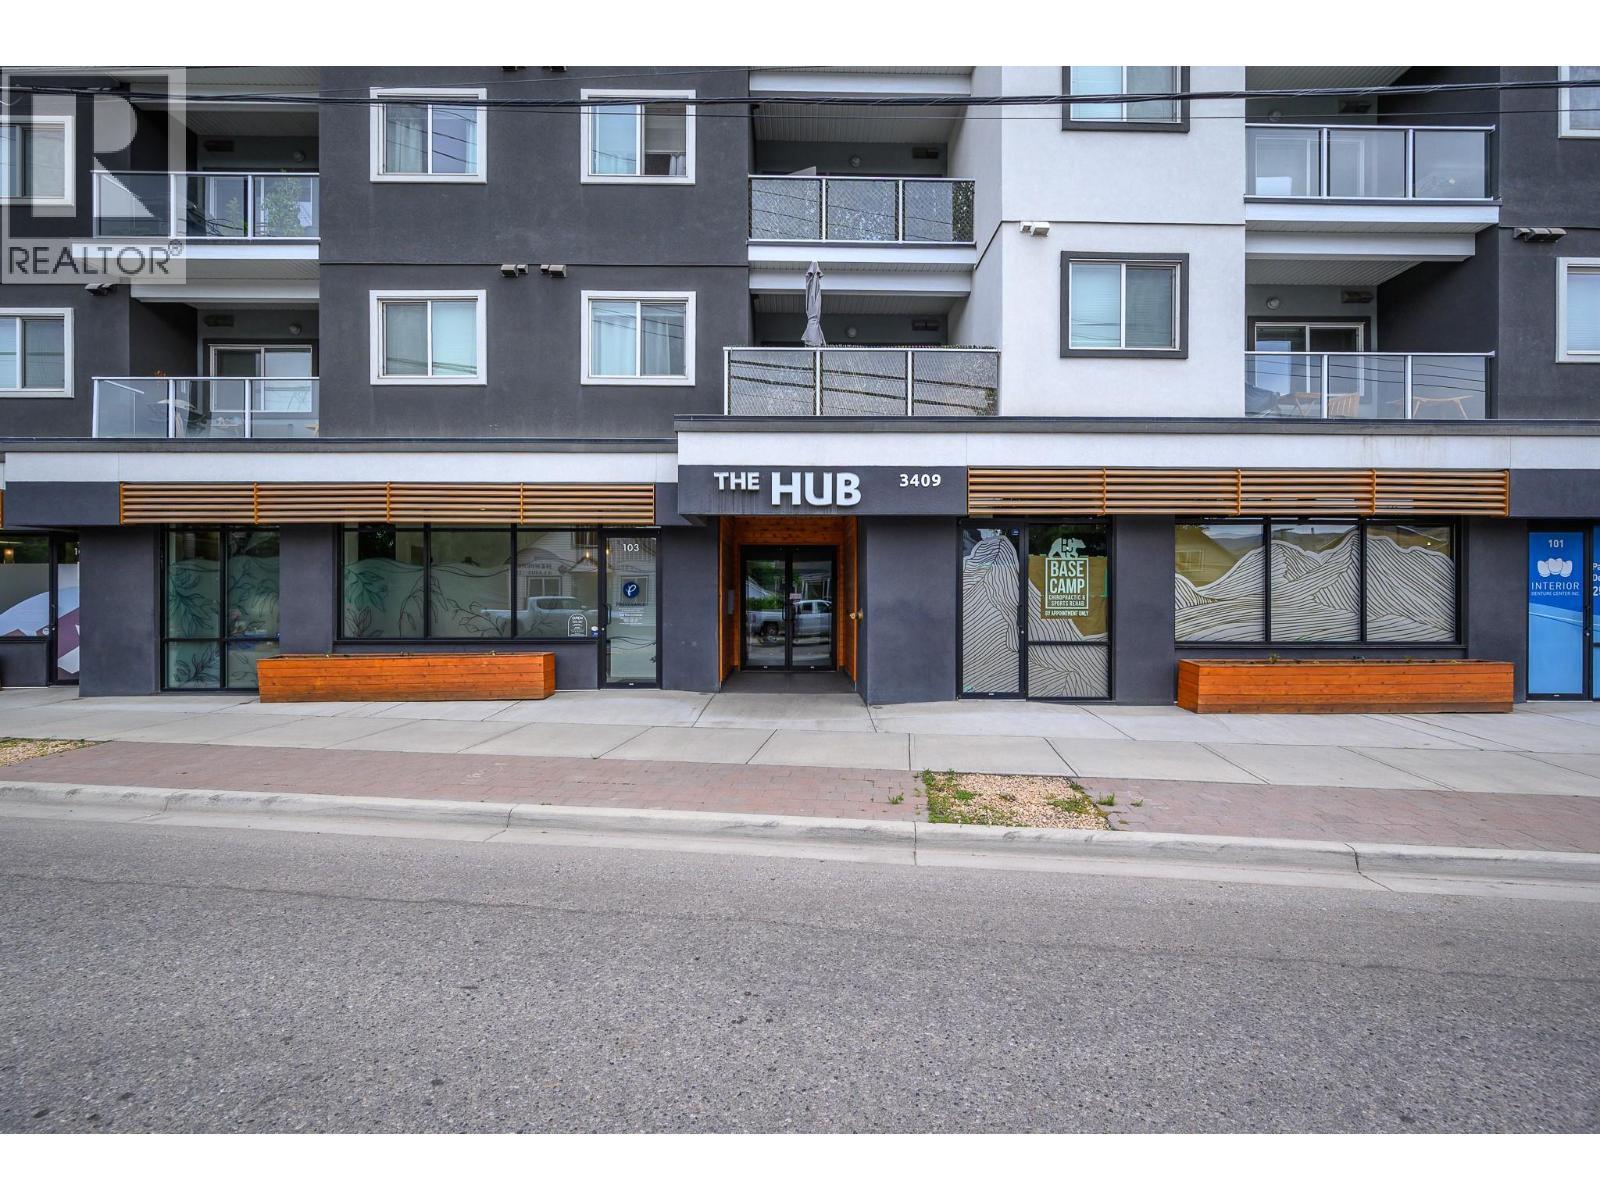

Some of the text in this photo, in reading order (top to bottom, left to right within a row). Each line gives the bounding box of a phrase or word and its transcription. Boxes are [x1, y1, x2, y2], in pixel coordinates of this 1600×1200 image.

[899, 473, 942, 488] 3409
[714, 471, 862, 507] THE HUB
[623, 543, 640, 552] 103
[1548, 539, 1564, 548] 101
[1050, 560, 1085, 577] BASE
[1049, 578, 1085, 594] CAMP
[1531, 581, 1580, 590] INTERIOR
